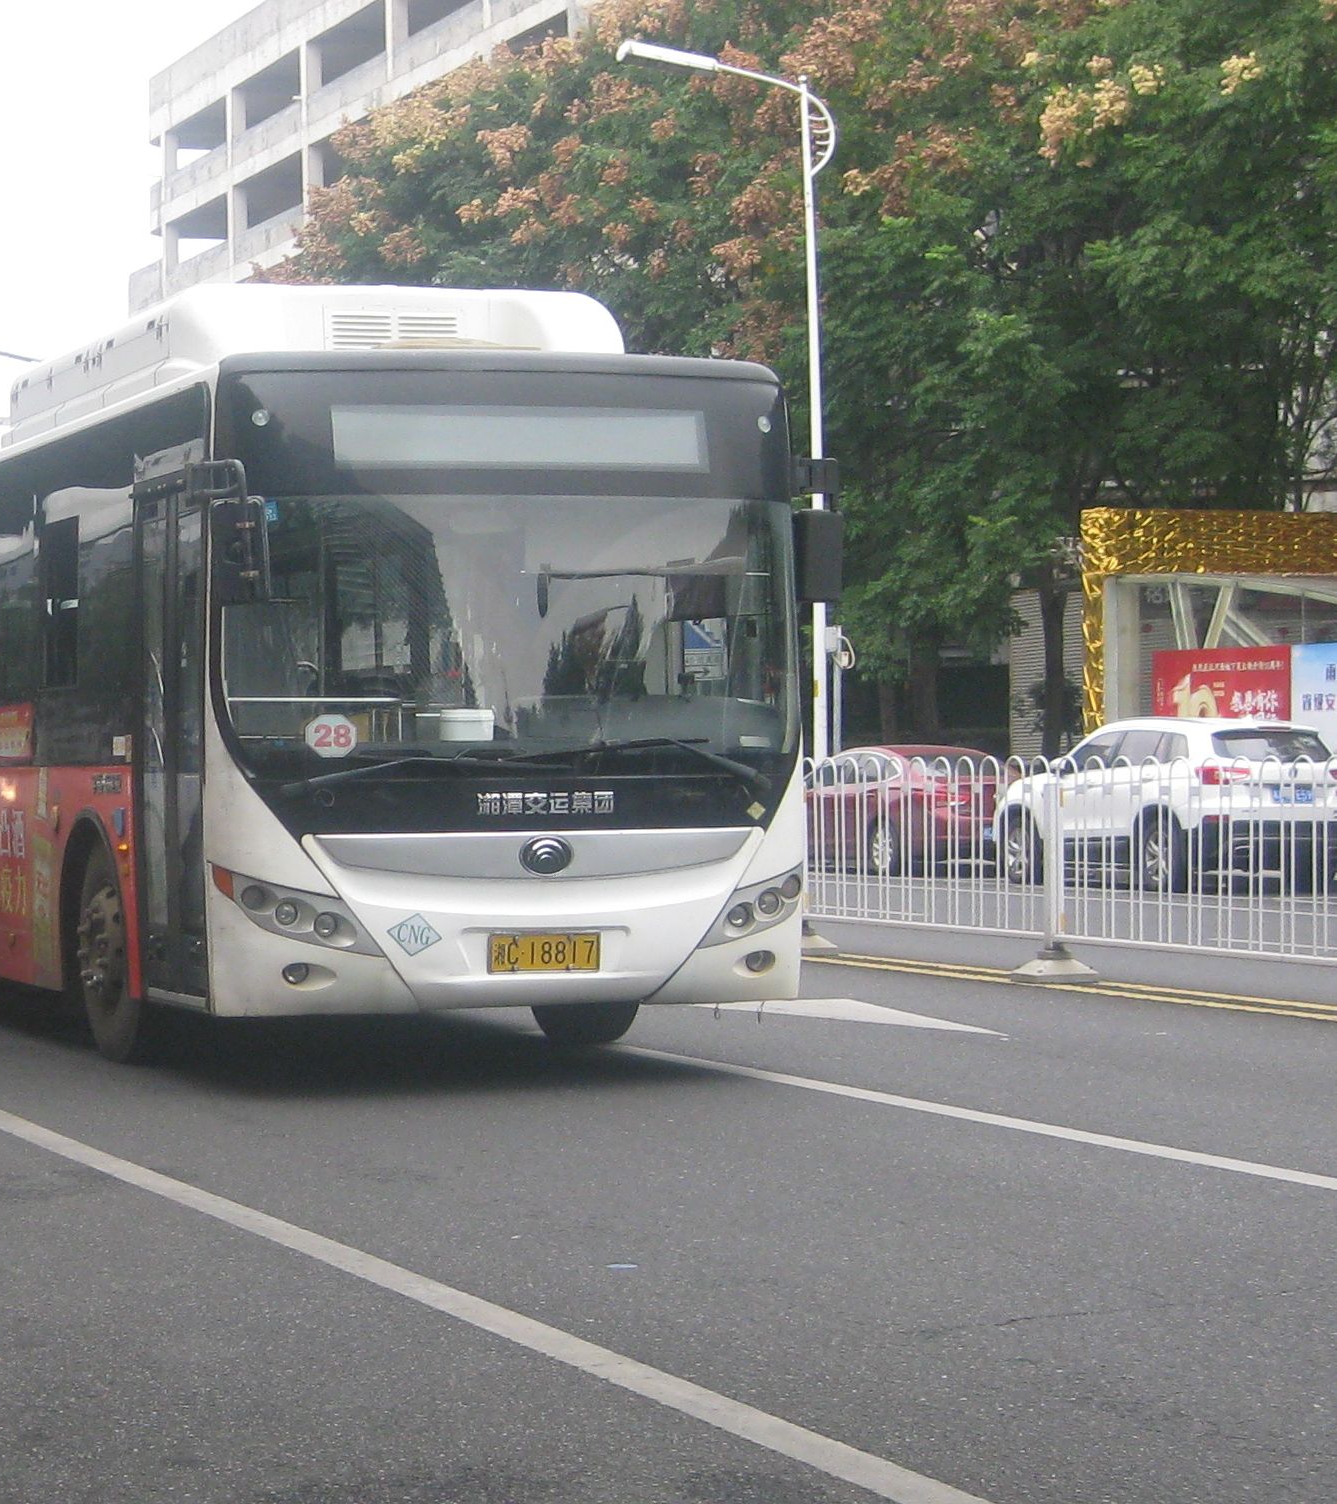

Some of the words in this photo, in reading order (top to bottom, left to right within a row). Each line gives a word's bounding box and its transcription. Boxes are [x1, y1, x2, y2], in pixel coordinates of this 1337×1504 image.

[313, 724, 352, 748] 28
[477, 791, 614, 815] 湘潭交运集团
[397, 923, 432, 946] CNG
